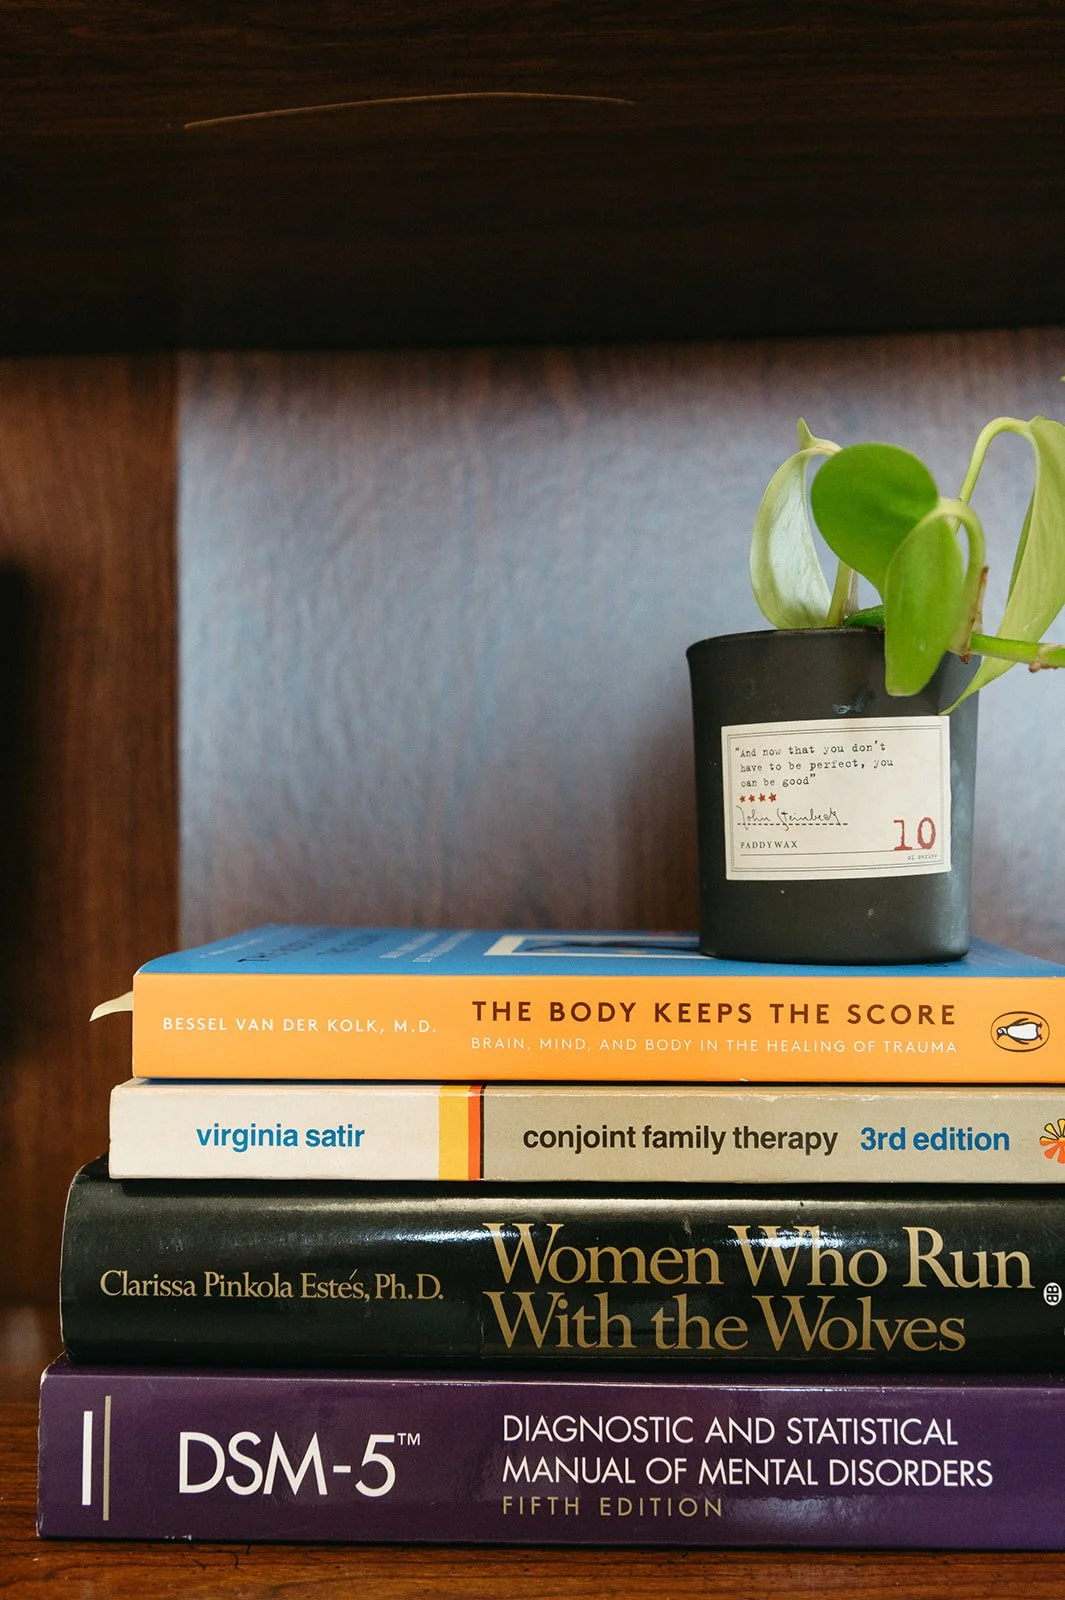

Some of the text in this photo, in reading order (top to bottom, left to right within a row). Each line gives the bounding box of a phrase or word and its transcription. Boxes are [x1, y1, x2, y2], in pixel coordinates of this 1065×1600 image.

[762, 748, 781, 757] now
[788, 745, 815, 755] that
[823, 745, 845, 756] you
[740, 758, 894, 773] have to be perfect, you
[740, 780, 757, 788] can
[763, 778, 775, 787] be
[740, 840, 799, 850] PADDYWAX
[893, 816, 937, 851] 10
[163, 1017, 437, 1035] BESSEL VAN DER KOLK, M.D.
[473, 1001, 955, 1025] THE BODY KEEPS THE SCORE
[471, 1037, 958, 1054] BRAIN, MIND, AND BODY IN THE HEALING OF TRAUMA
[196, 1123, 365, 1153] virginia satir
[523, 1125, 1010, 1156] conjoint family therapy 3rd edition
[482, 1222, 1036, 1289] Women Who Run
[100, 1269, 198, 1297] Clarissa
[203, 1271, 294, 1299] Pinkola
[300, 1269, 371, 1302] Estés,
[482, 1291, 966, 1352] With the Wolves
[503, 1414, 959, 1446] DIAGNOSTIC AND STATISTICAL
[502, 1456, 994, 1488] MANUAL OF MENTAL DISORDERS
[502, 1495, 722, 1518] FIFTH EDITION
